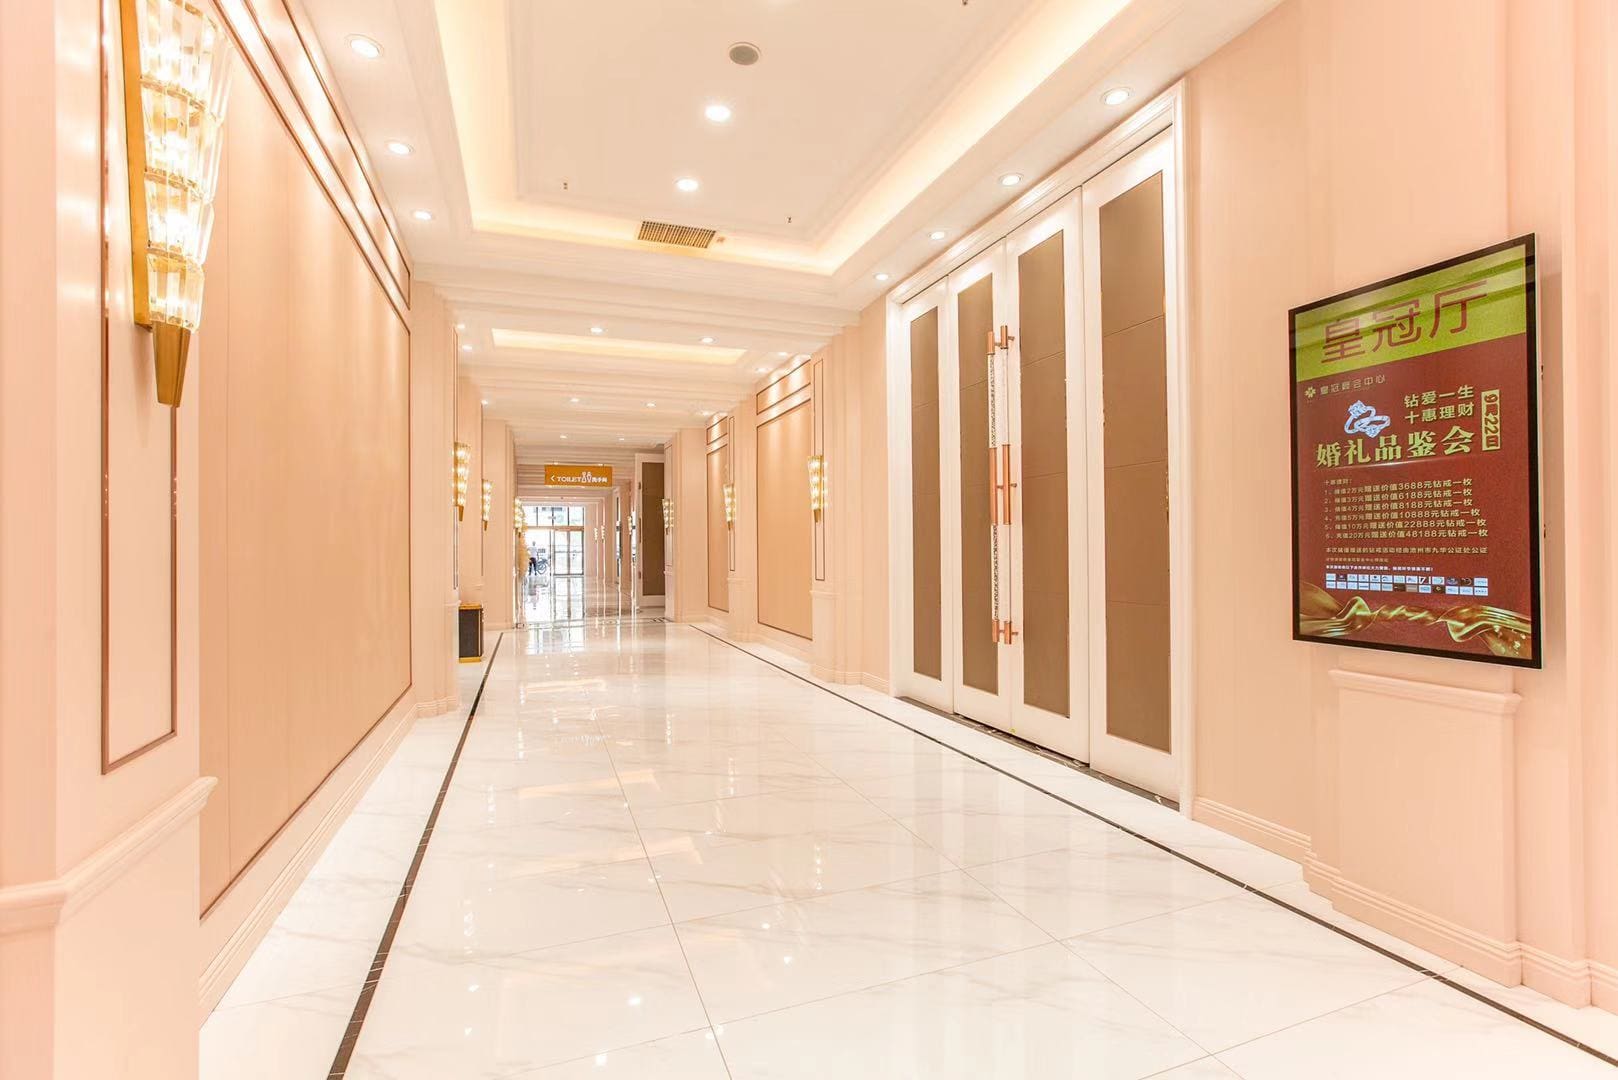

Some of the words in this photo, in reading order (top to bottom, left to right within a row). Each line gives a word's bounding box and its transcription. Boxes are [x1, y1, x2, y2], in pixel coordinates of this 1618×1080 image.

[1321, 280, 1488, 363] 皇冠厅
[1404, 384, 1475, 408] 钻爱一生
[1404, 401, 1475, 424] 十惠理财
[1316, 425, 1475, 468] 婚礼品鉴会
